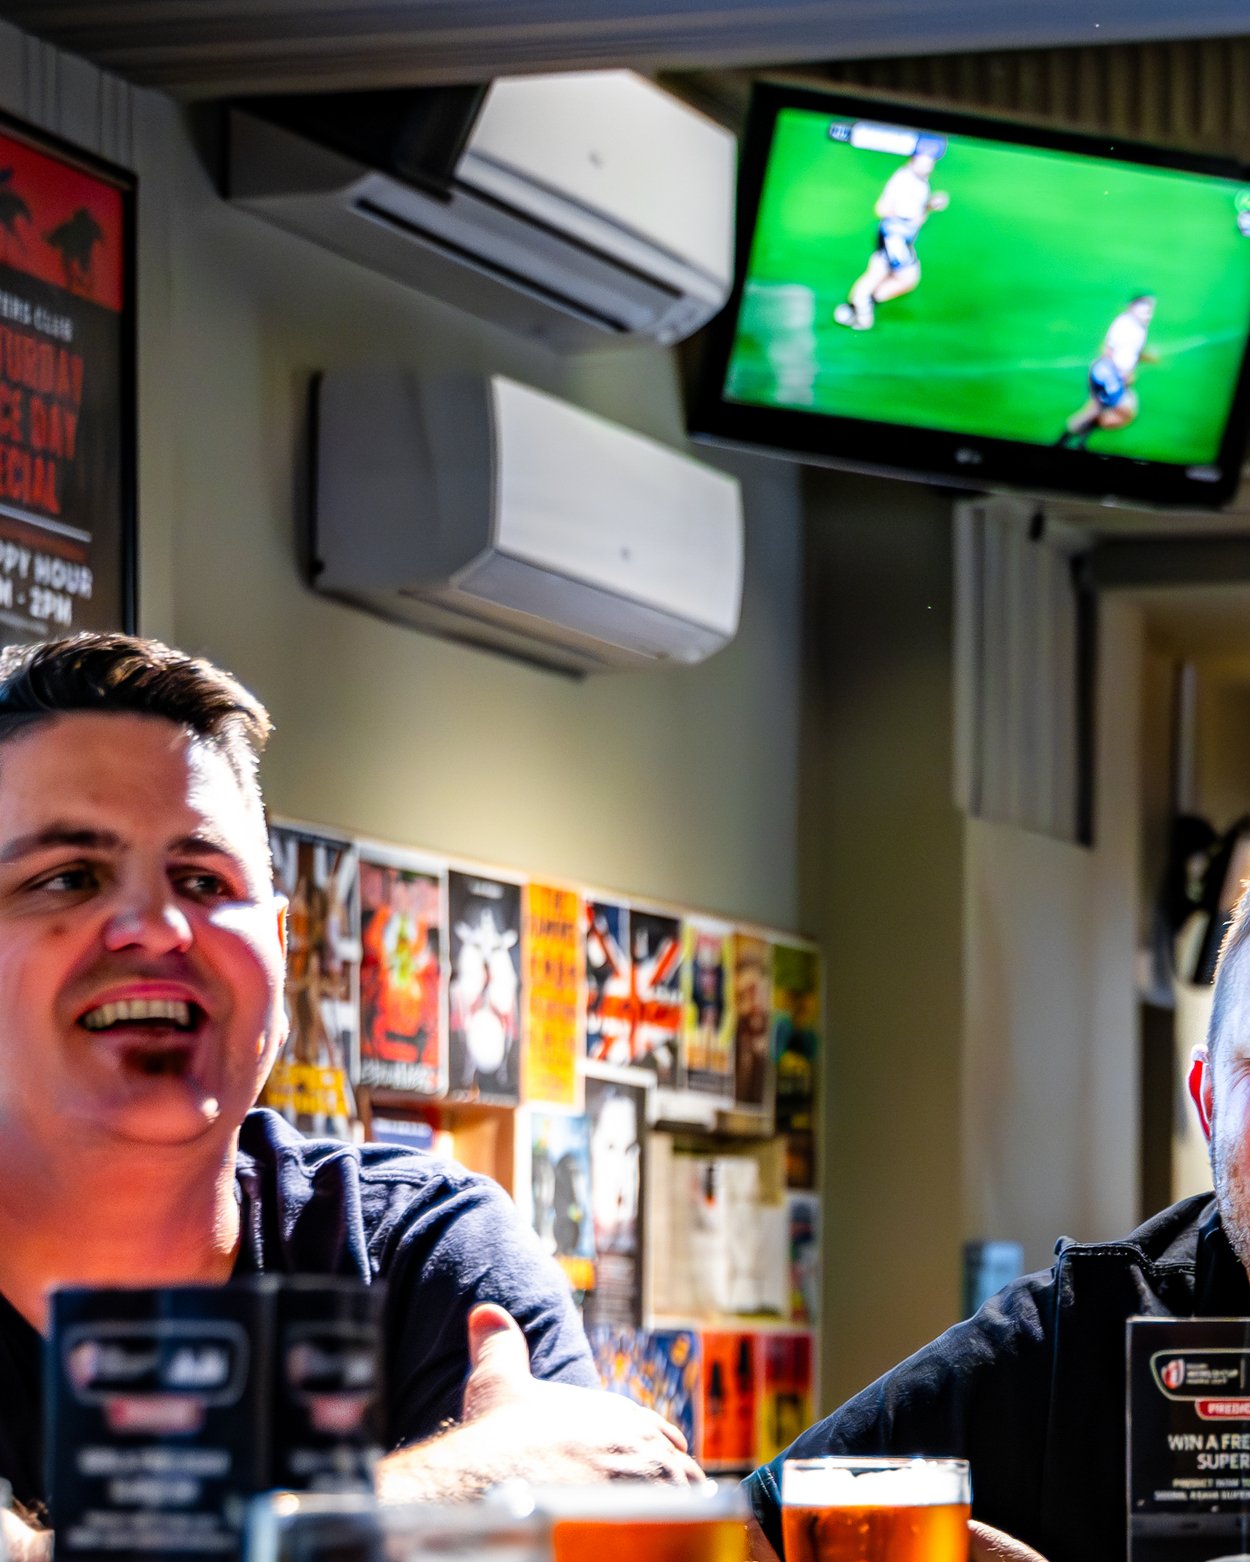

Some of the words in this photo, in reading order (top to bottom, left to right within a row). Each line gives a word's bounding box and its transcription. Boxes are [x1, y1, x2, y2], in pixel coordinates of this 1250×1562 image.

[30, 396, 78, 463] DAY
[34, 552, 93, 600] HOUR
[29, 584, 72, 627] 2PM
[1167, 1433, 1203, 1451] WIN
[1205, 1433, 1218, 1451] A
